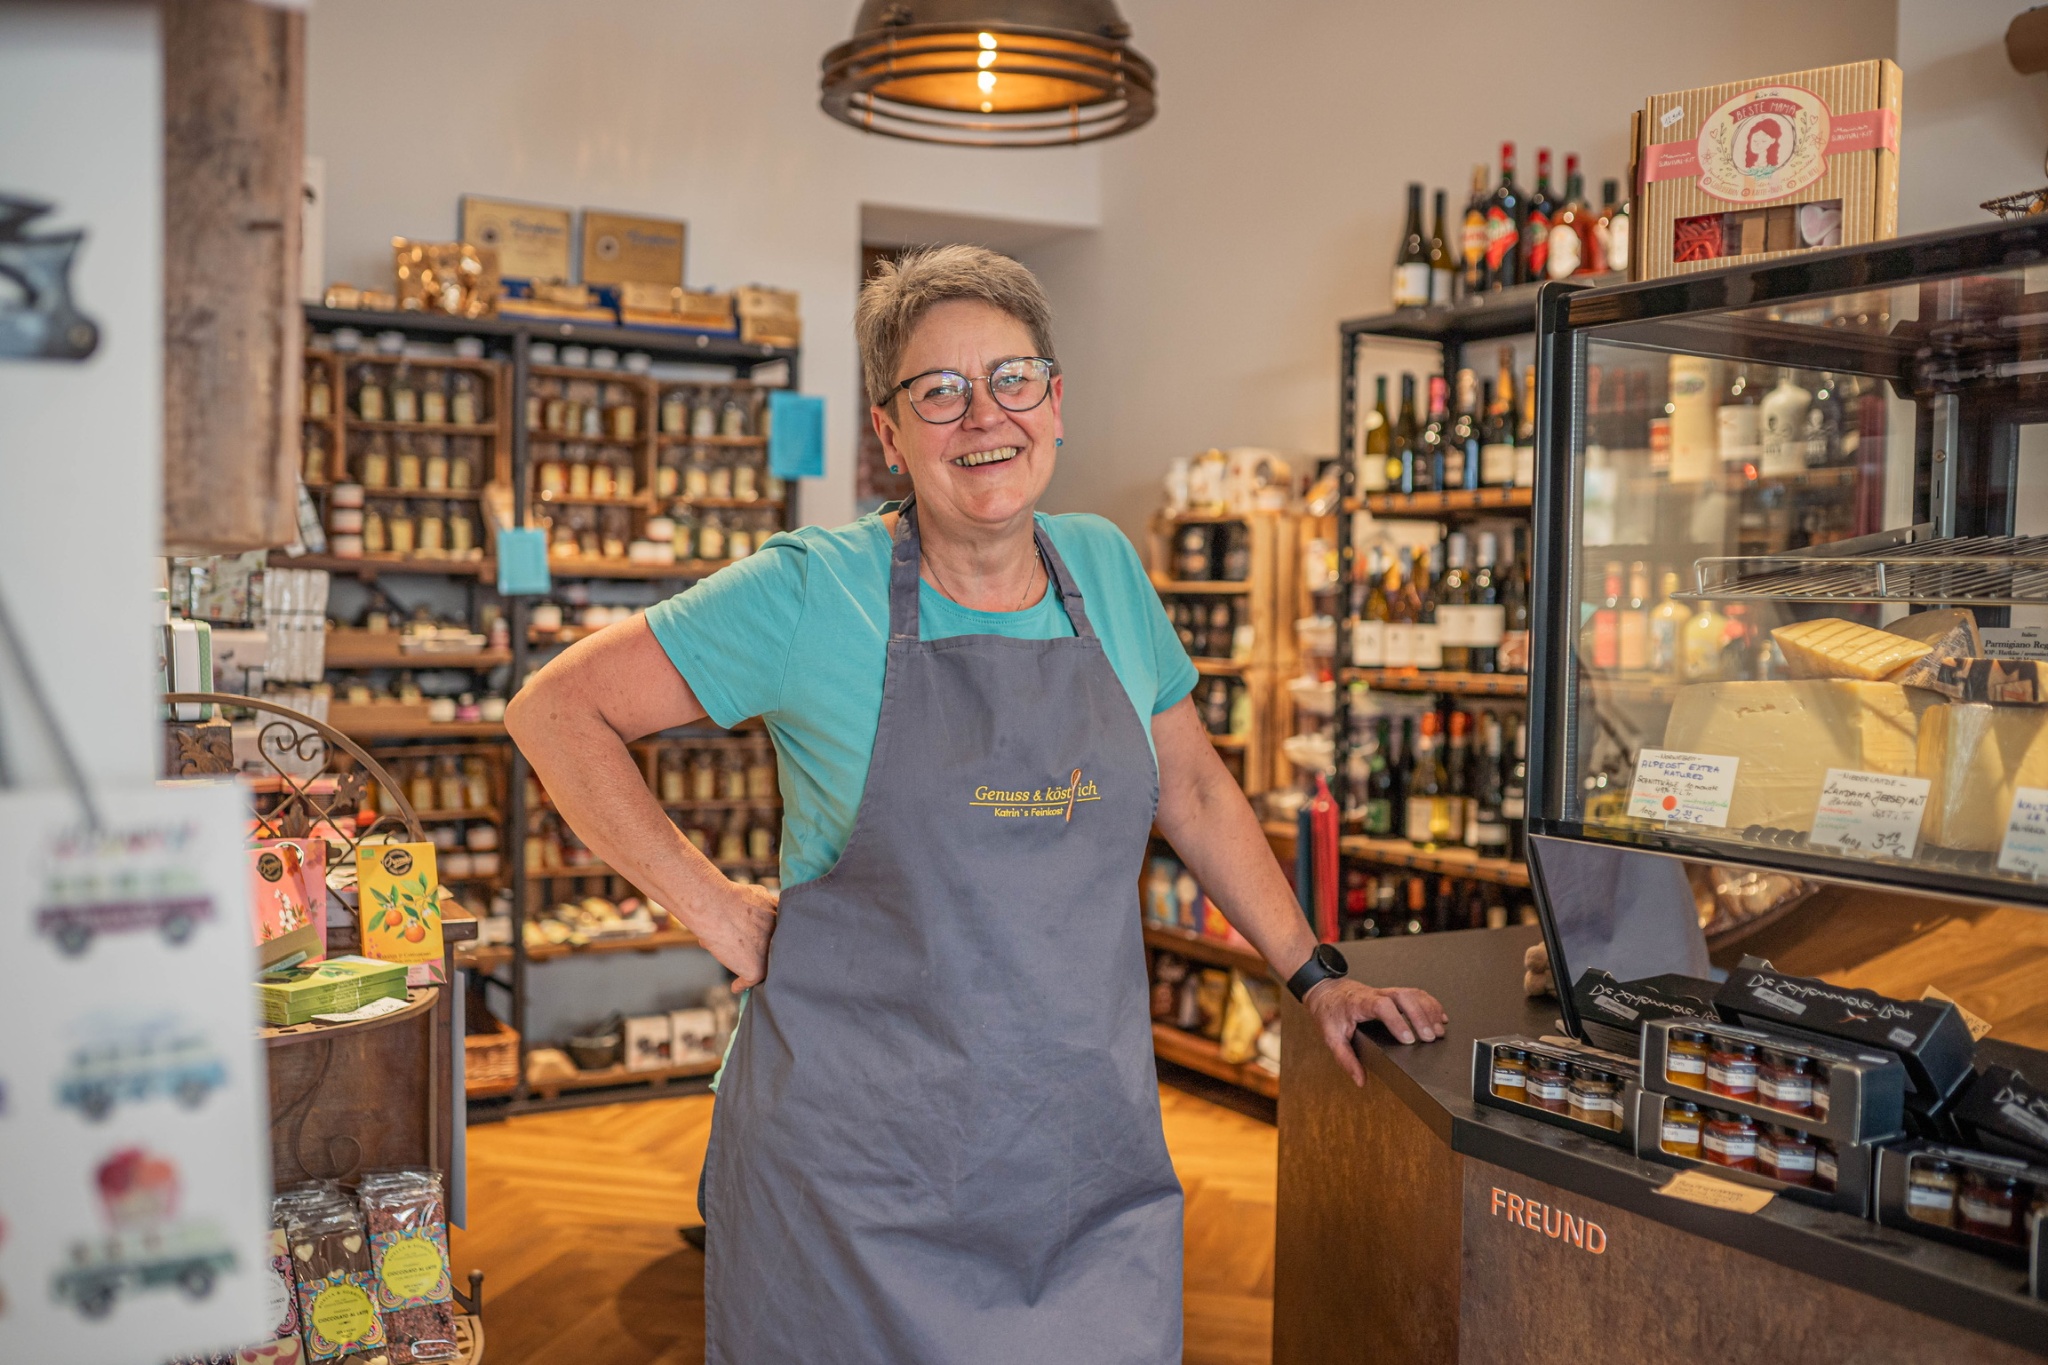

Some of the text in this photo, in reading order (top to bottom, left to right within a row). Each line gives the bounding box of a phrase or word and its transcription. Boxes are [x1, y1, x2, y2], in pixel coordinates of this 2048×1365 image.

[1735, 101, 1797, 121] BESTE MAMA
[1984, 639, 2031, 650] Parmigiano
[1641, 760, 1720, 774] ALPEOST EXTRA
[1663, 769, 1704, 781] MATURED
[975, 785, 1030, 802] Genuss
[1032, 789, 1042, 802] &
[1823, 782, 1871, 800] LANDANA
[1030, 806, 1064, 817] Feinkost
[1491, 1186, 1607, 1255] FREUND
